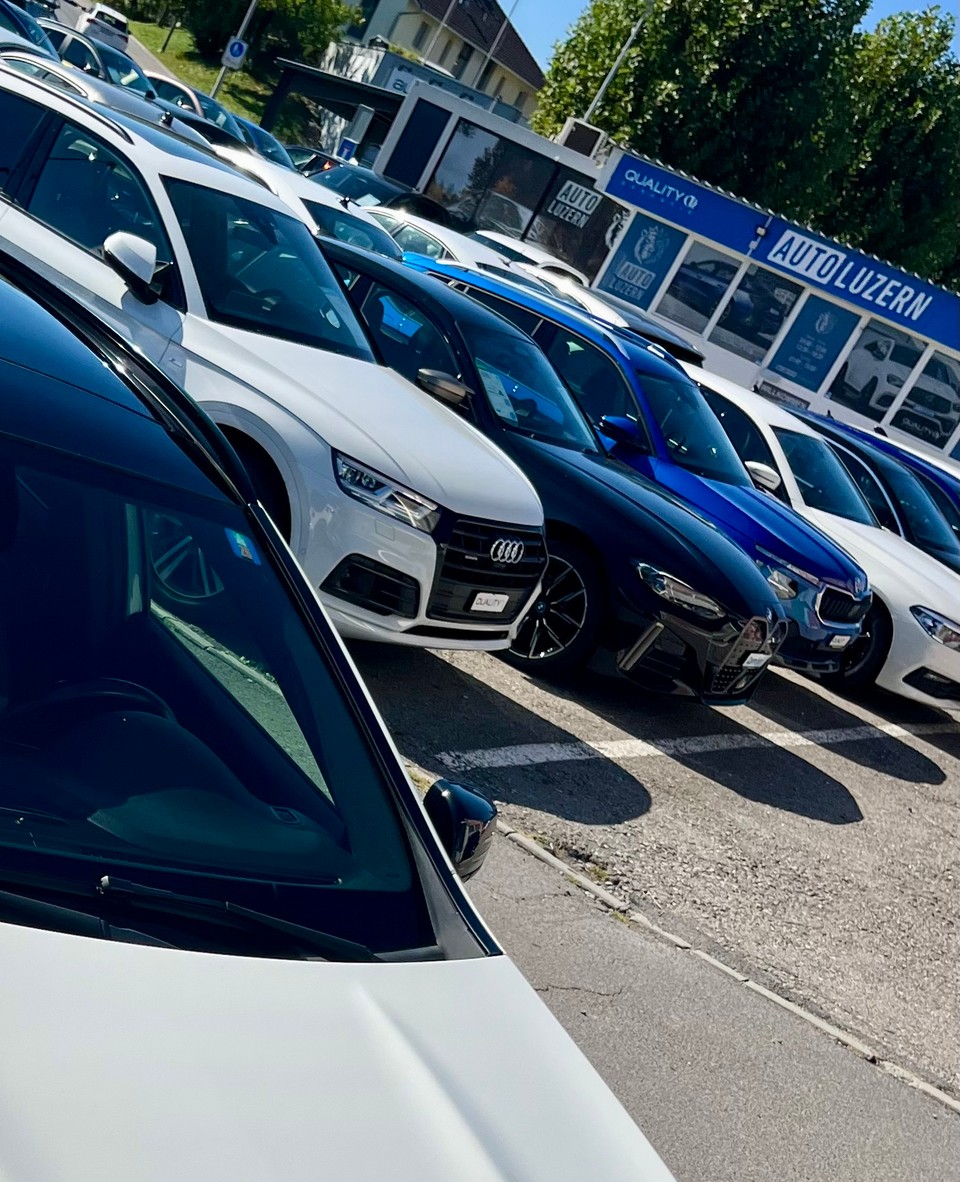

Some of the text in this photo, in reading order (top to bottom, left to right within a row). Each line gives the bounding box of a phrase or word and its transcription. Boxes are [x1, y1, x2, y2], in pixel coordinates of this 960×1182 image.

[557, 183, 600, 212] AUTO
[546, 200, 590, 229] LUZERN
[618, 263, 655, 288] AUTO
[772, 235, 934, 322] AUTO LUZERN
